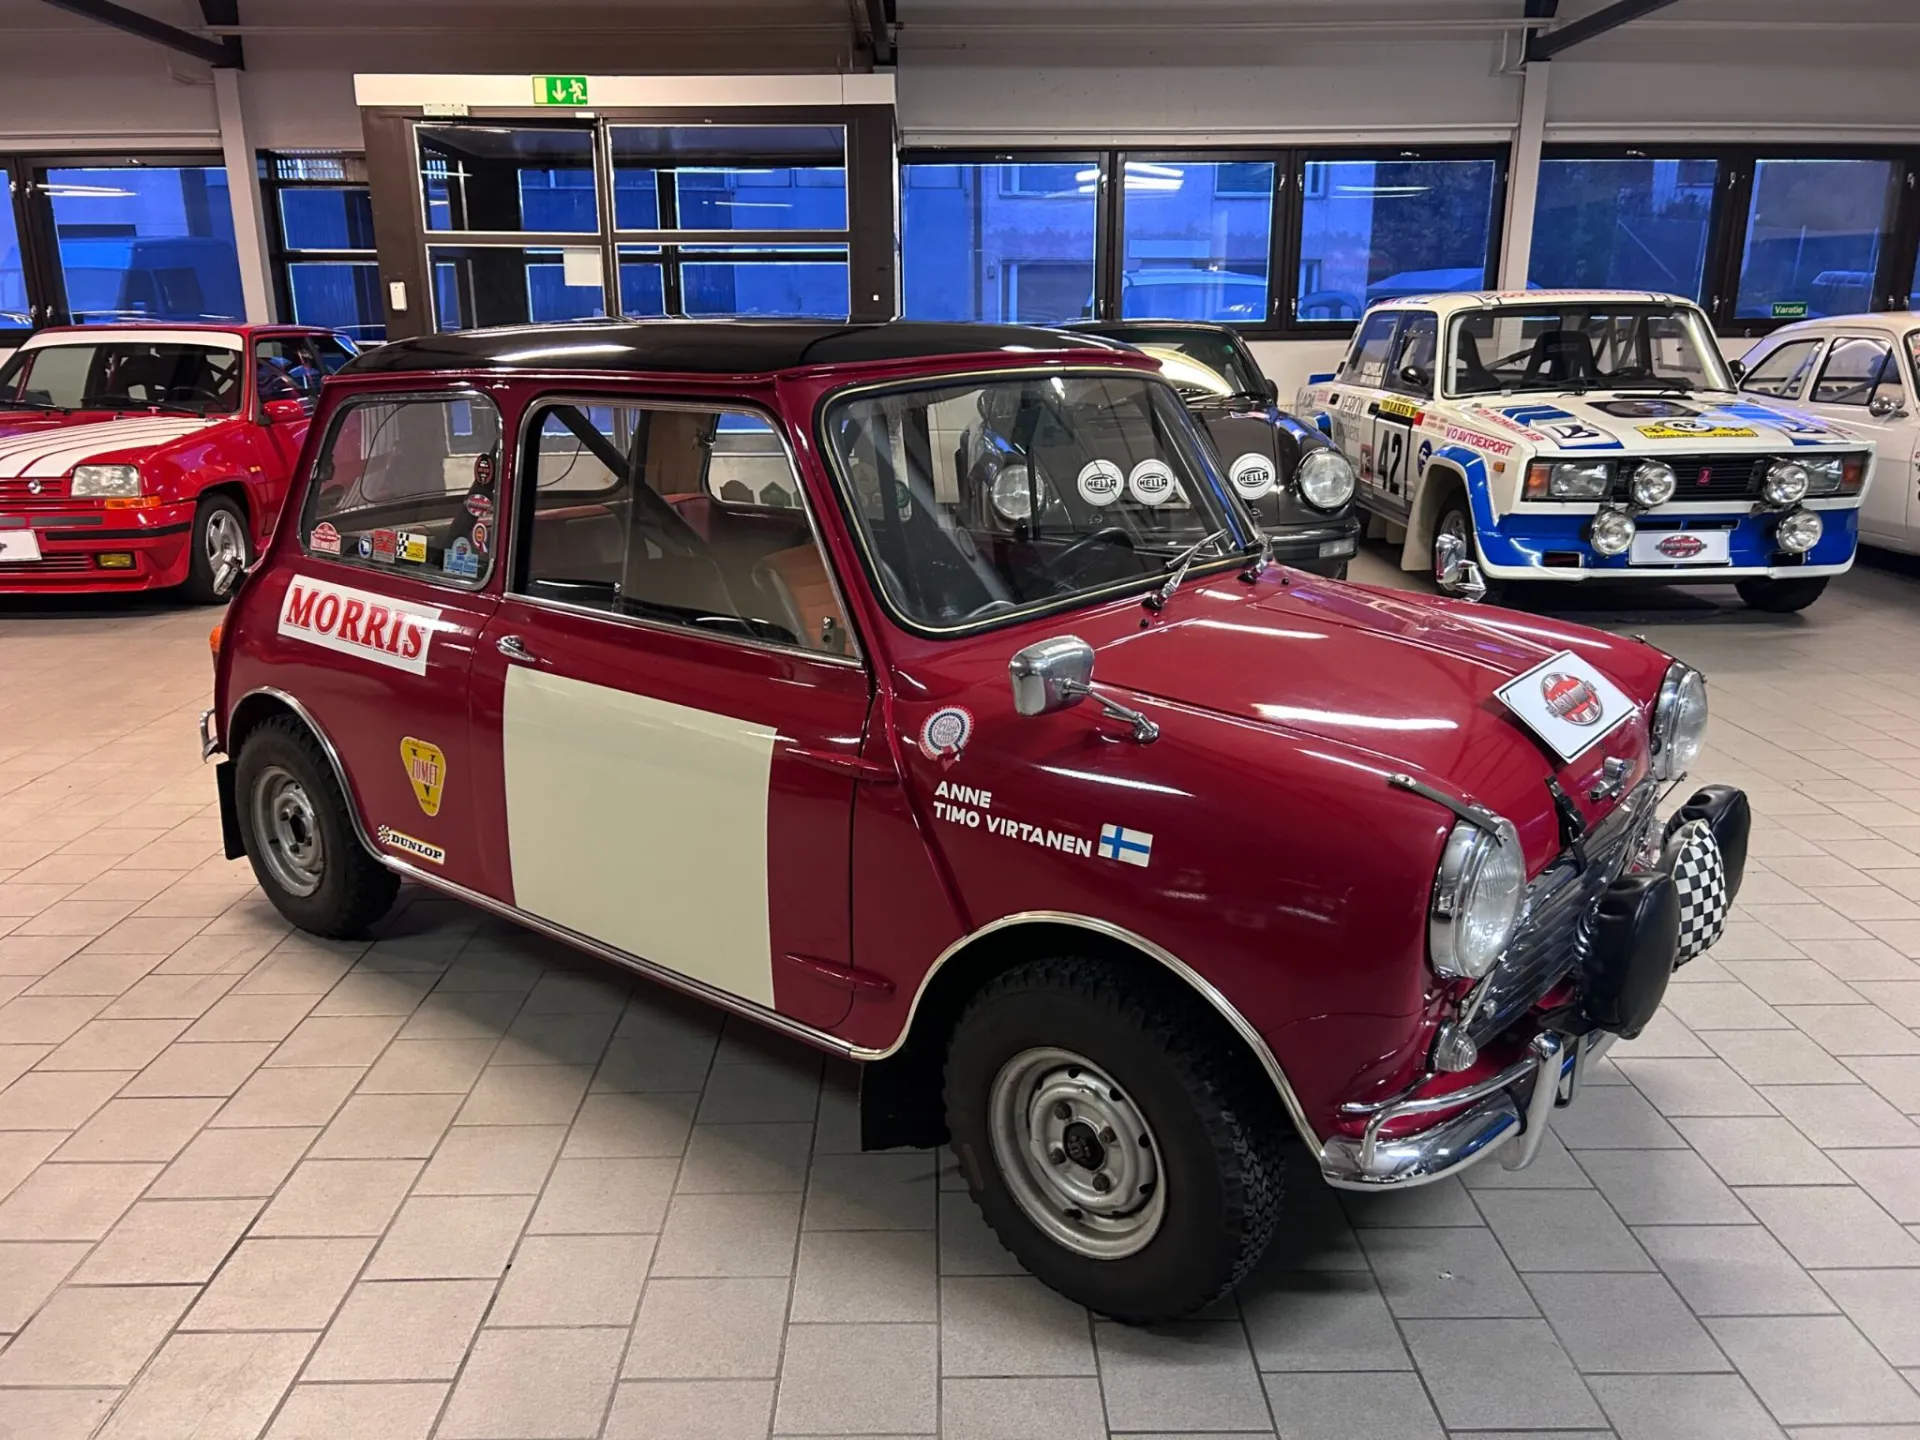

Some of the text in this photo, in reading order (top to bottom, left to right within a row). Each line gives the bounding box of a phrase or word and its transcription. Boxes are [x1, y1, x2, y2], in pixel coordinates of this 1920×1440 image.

[1774, 305, 1804, 314] Varatie
[1377, 430, 1403, 495] 42
[1087, 478, 1117, 488] HELLA
[1138, 477, 1168, 488] HELLA
[1240, 472, 1269, 482] HELLA
[284, 584, 425, 661] MORRIS
[935, 781, 992, 809] ANNE
[933, 801, 1093, 858] TIMO VIRTANEN
[390, 833, 443, 860] DUNLOP
